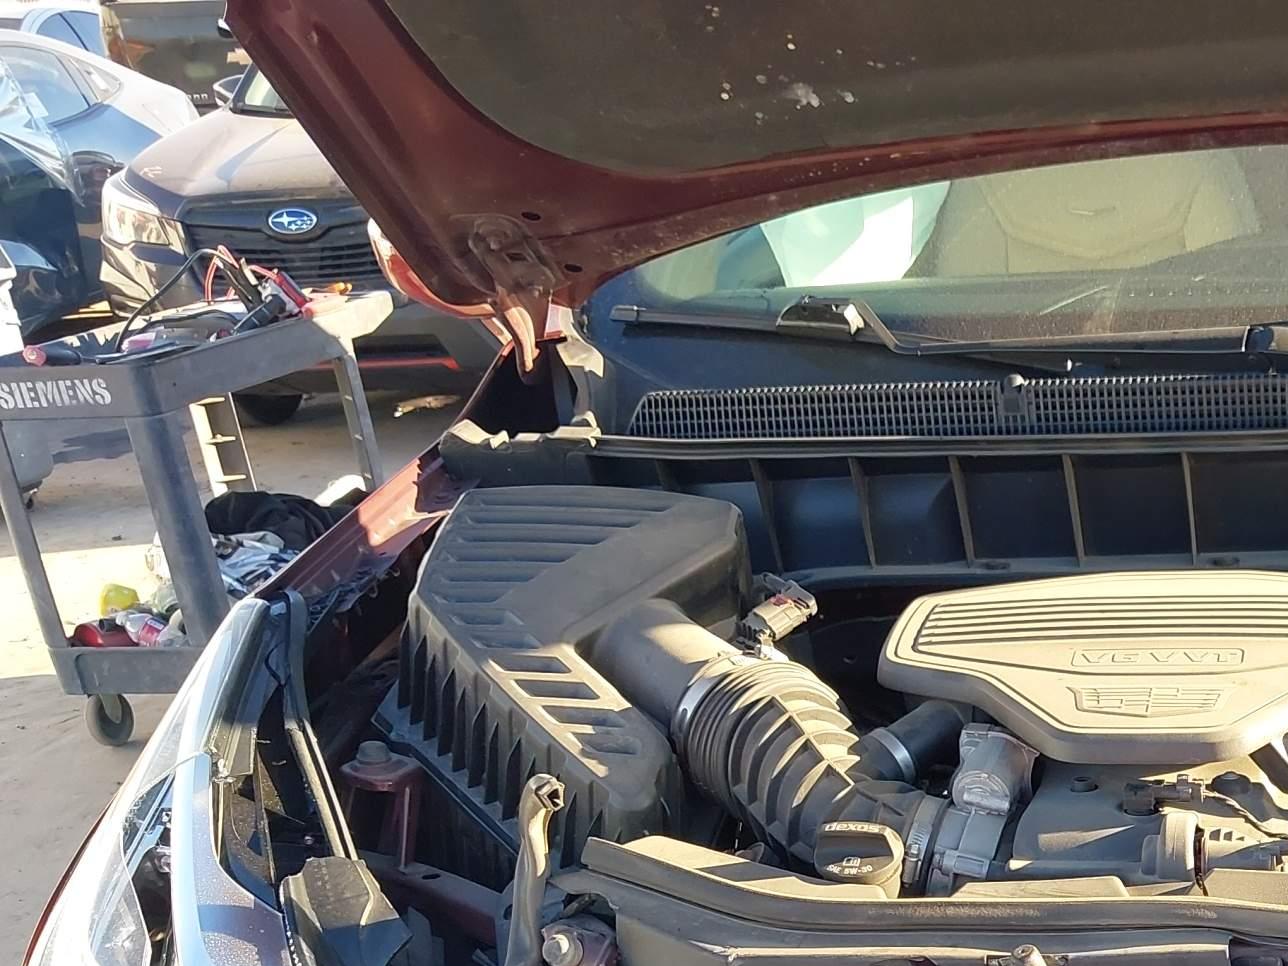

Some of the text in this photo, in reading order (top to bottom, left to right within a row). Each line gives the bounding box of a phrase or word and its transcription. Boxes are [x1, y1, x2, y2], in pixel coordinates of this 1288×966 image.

[0, 378, 112, 409] SIEMENS
[824, 822, 881, 833] dexos
[843, 864, 873, 875] 5W-30
